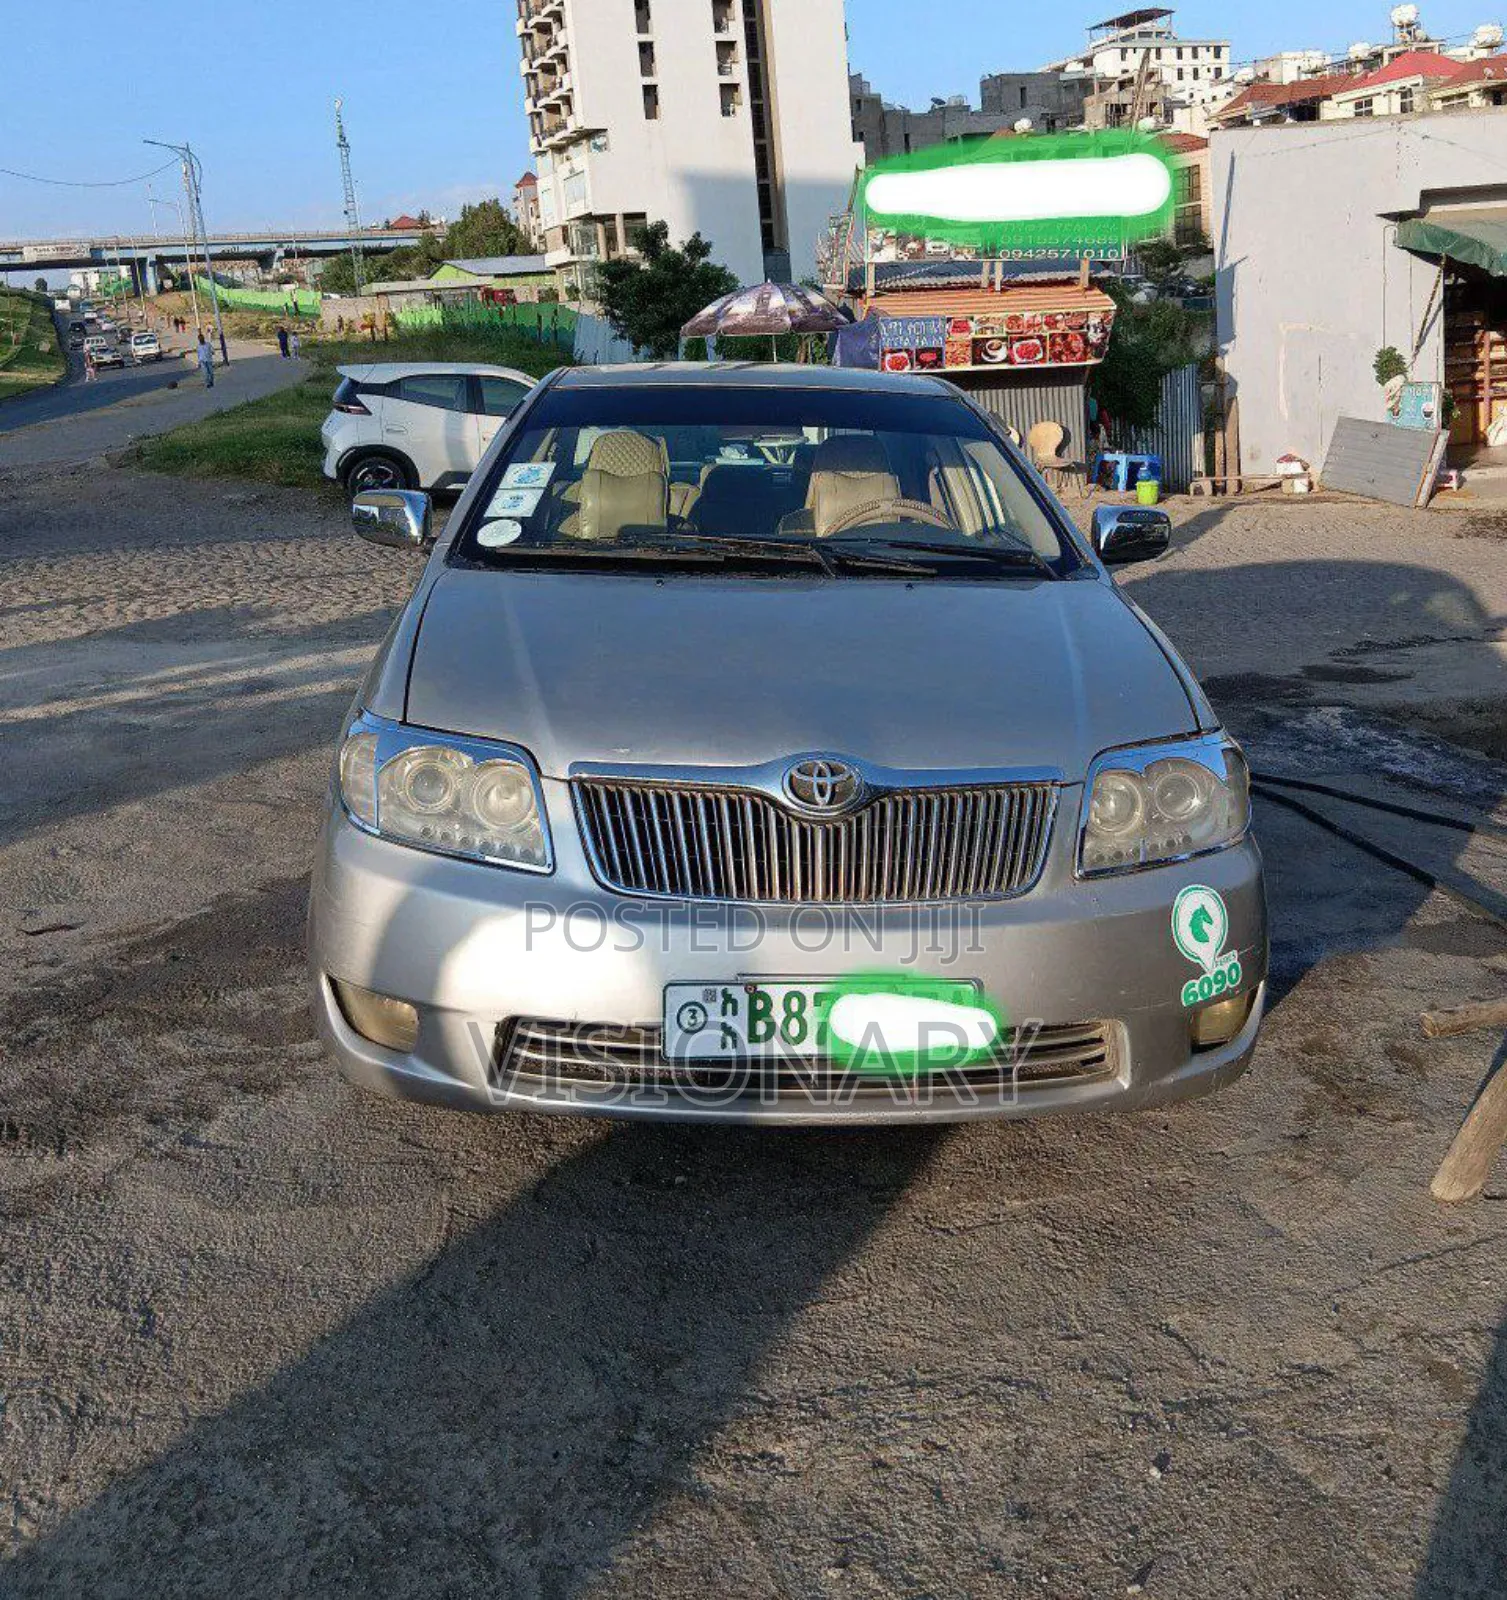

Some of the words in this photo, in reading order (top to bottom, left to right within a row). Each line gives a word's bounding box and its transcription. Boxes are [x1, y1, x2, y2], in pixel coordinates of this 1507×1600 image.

[999, 249, 1119, 259] 0942571010
[1182, 961, 1241, 1007] 6090
[686, 1007, 698, 1028] 3
